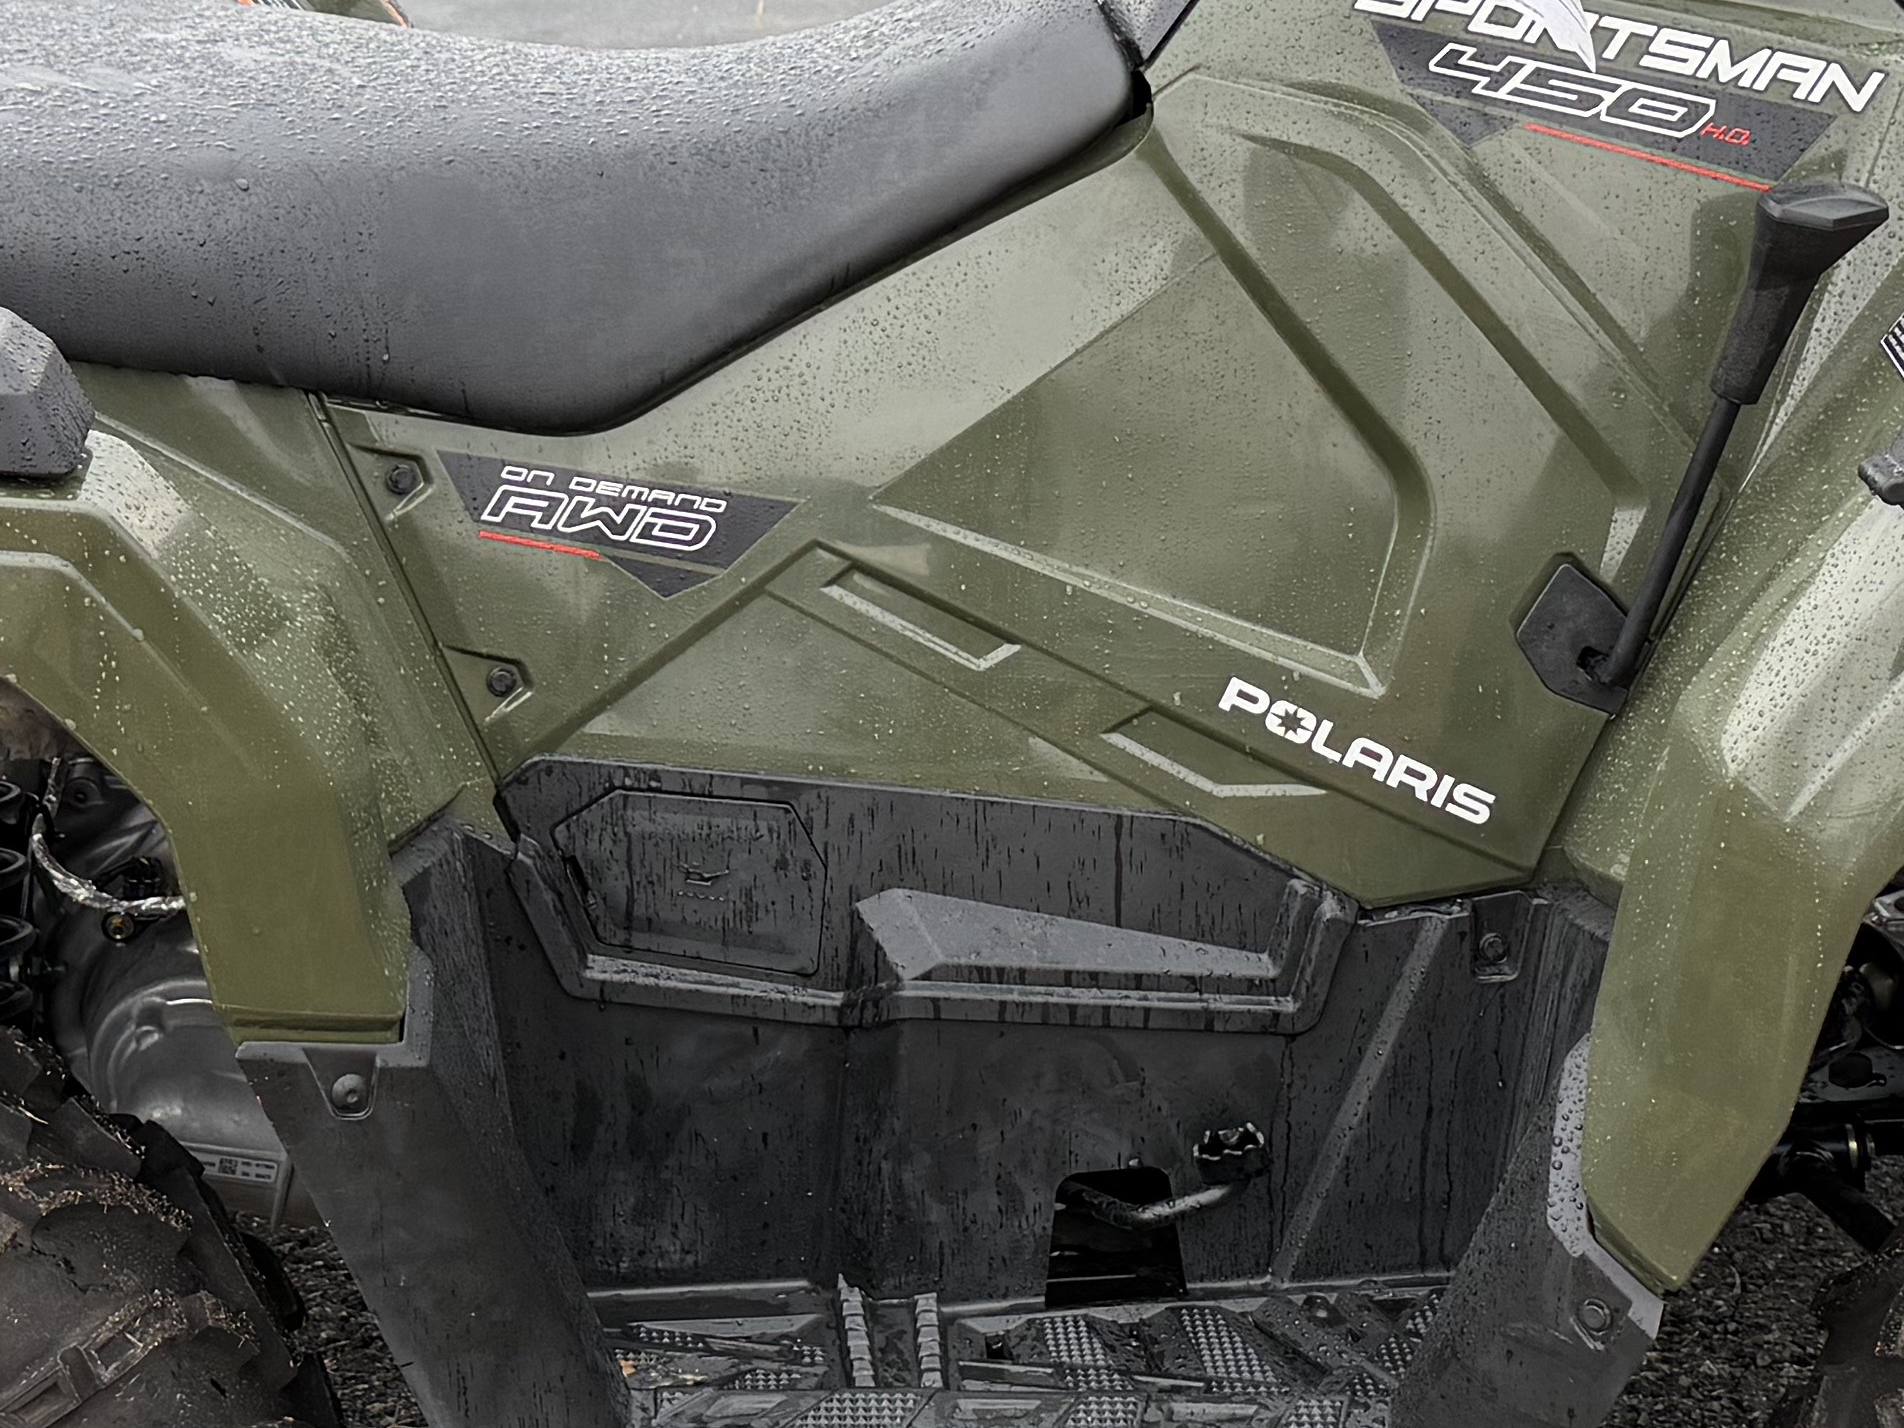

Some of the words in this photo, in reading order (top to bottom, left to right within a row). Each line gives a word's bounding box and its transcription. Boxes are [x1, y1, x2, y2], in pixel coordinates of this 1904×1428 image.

[1428, 41, 1718, 139] 450
[481, 484, 716, 551] AWD
[500, 465, 556, 486] ON
[569, 475, 728, 514] DEMAND
[1218, 676, 1496, 825] POLARIS
